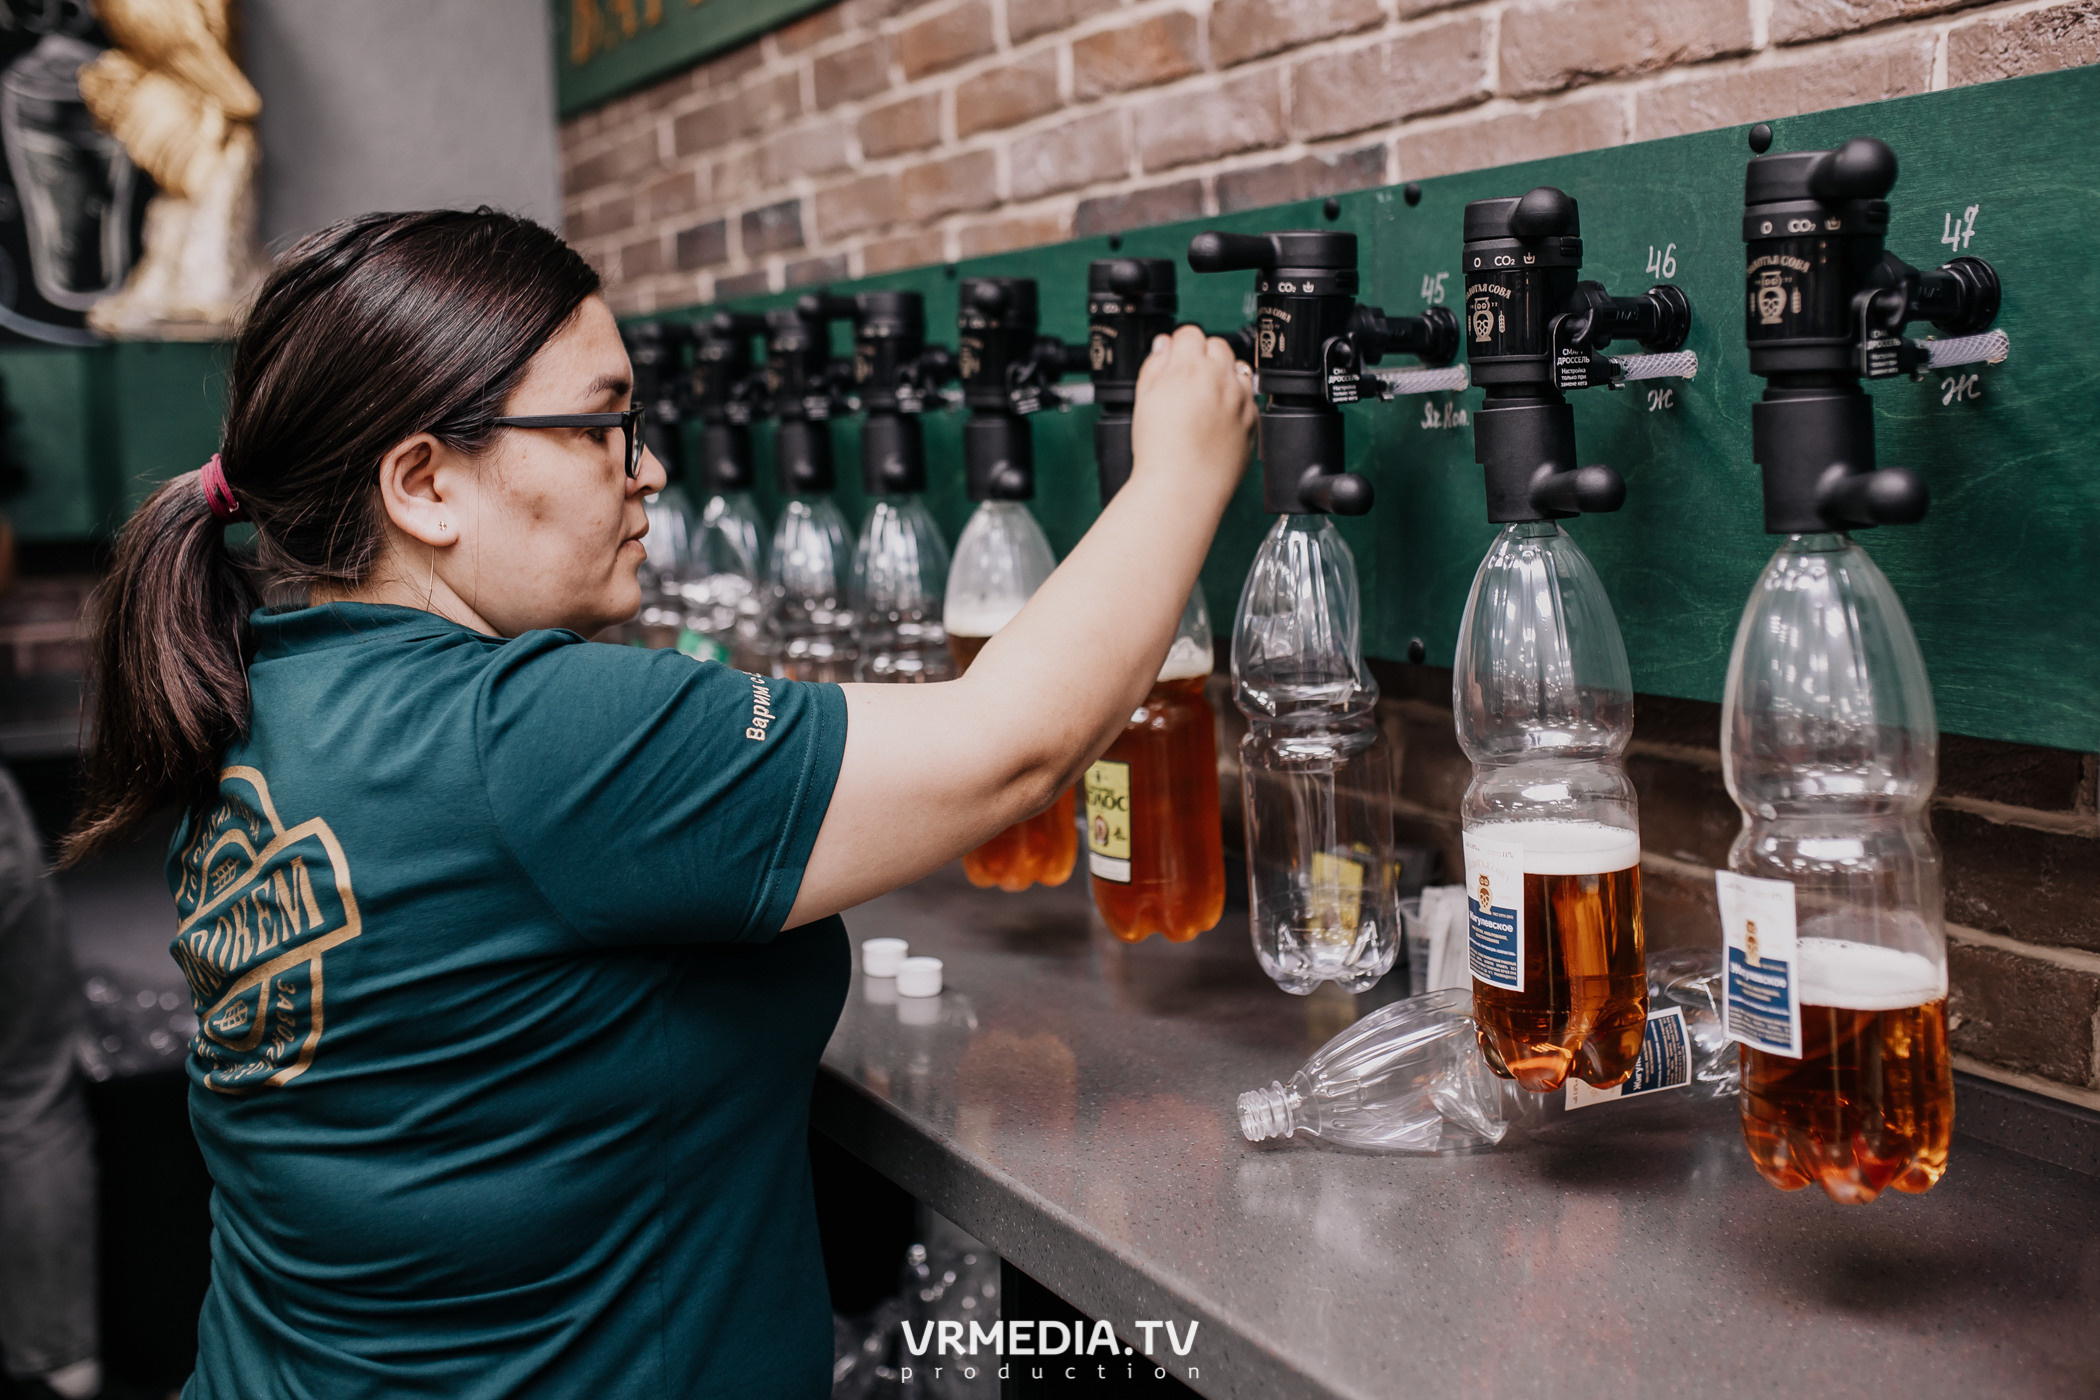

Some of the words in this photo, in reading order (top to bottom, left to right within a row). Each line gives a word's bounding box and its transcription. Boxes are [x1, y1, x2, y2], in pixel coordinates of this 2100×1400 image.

[1940, 203, 1979, 252] 47
[1645, 242, 1677, 279] 46
[1420, 272, 1450, 305] 45
[1488, 283, 1512, 300] СОВА
[1557, 356, 1591, 366] ДРОССЕЛЬ
[745, 684, 776, 741] Варим
